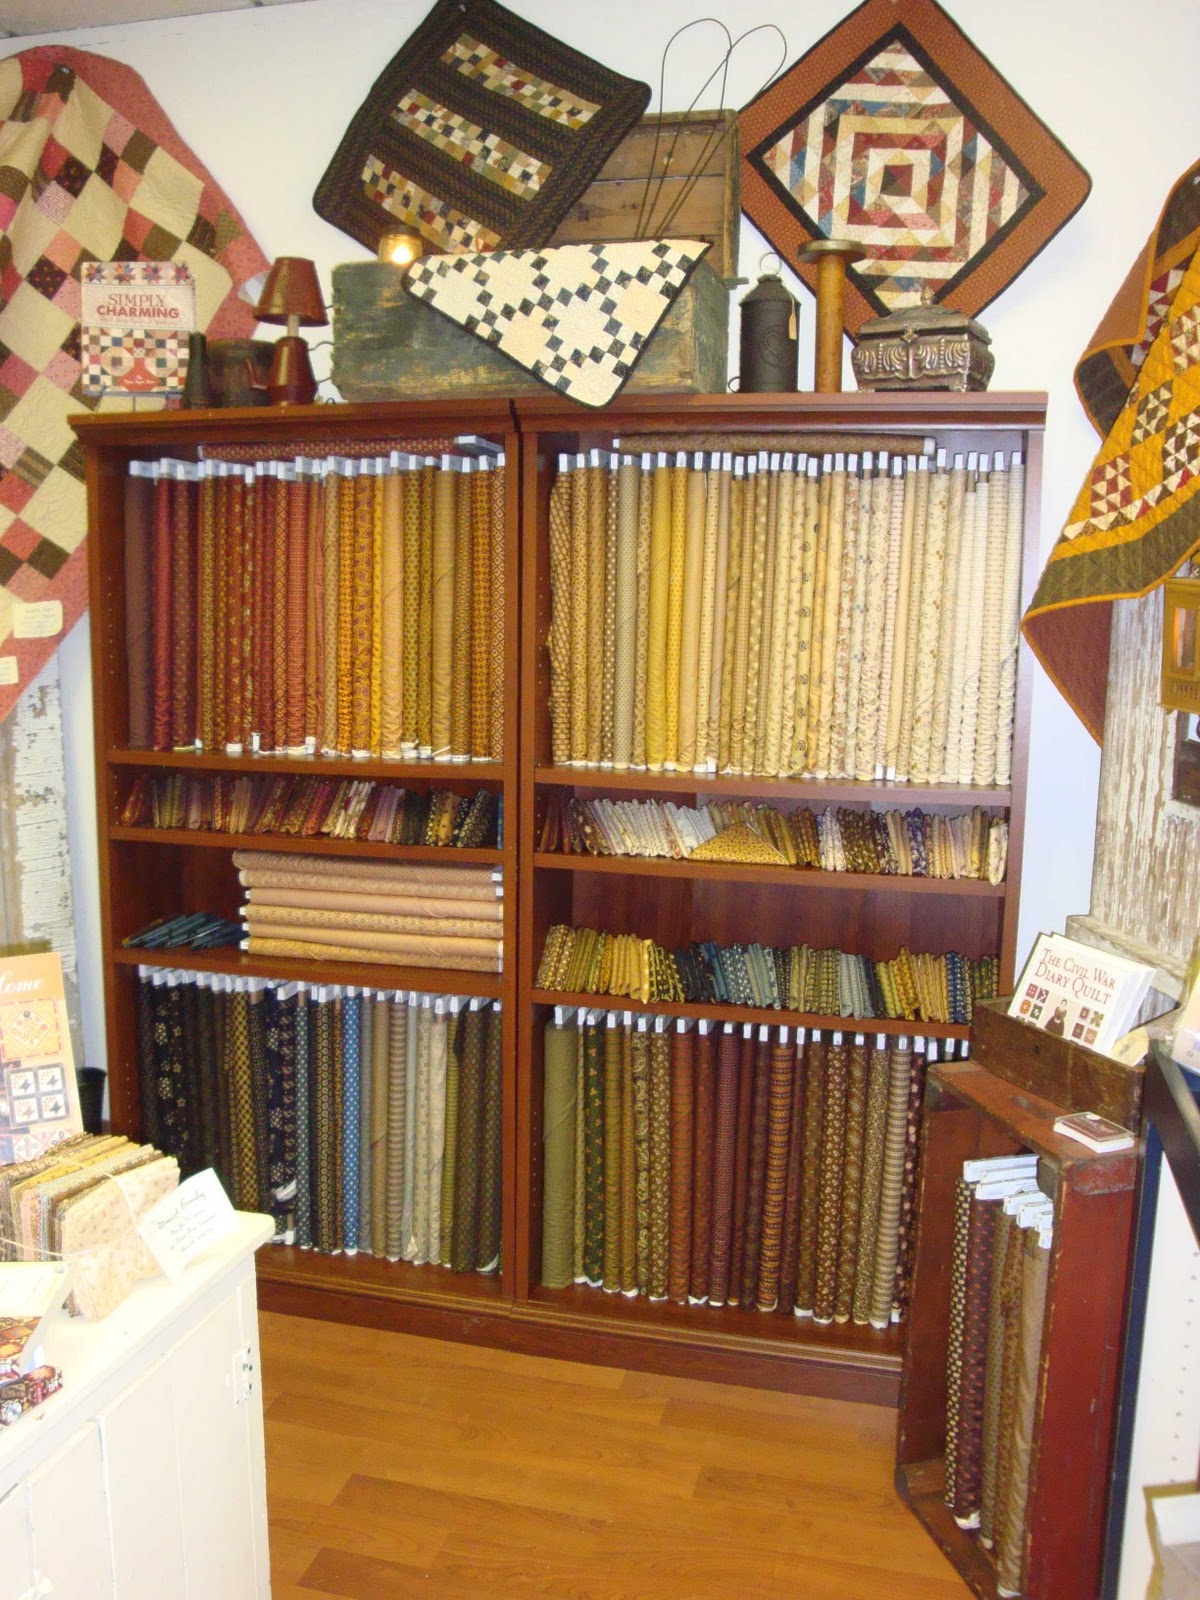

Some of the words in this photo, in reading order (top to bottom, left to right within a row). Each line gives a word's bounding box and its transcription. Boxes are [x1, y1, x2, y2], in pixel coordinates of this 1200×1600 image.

[96, 305, 180, 319] CHARMING
[108, 293, 166, 308] SIMPLY
[1034, 961, 1071, 988] DIARY
[1071, 976, 1112, 1004] QUILT
[1043, 948, 1062, 968] THE
[1063, 957, 1089, 979] CIVIL
[1093, 967, 1116, 989] WAR
